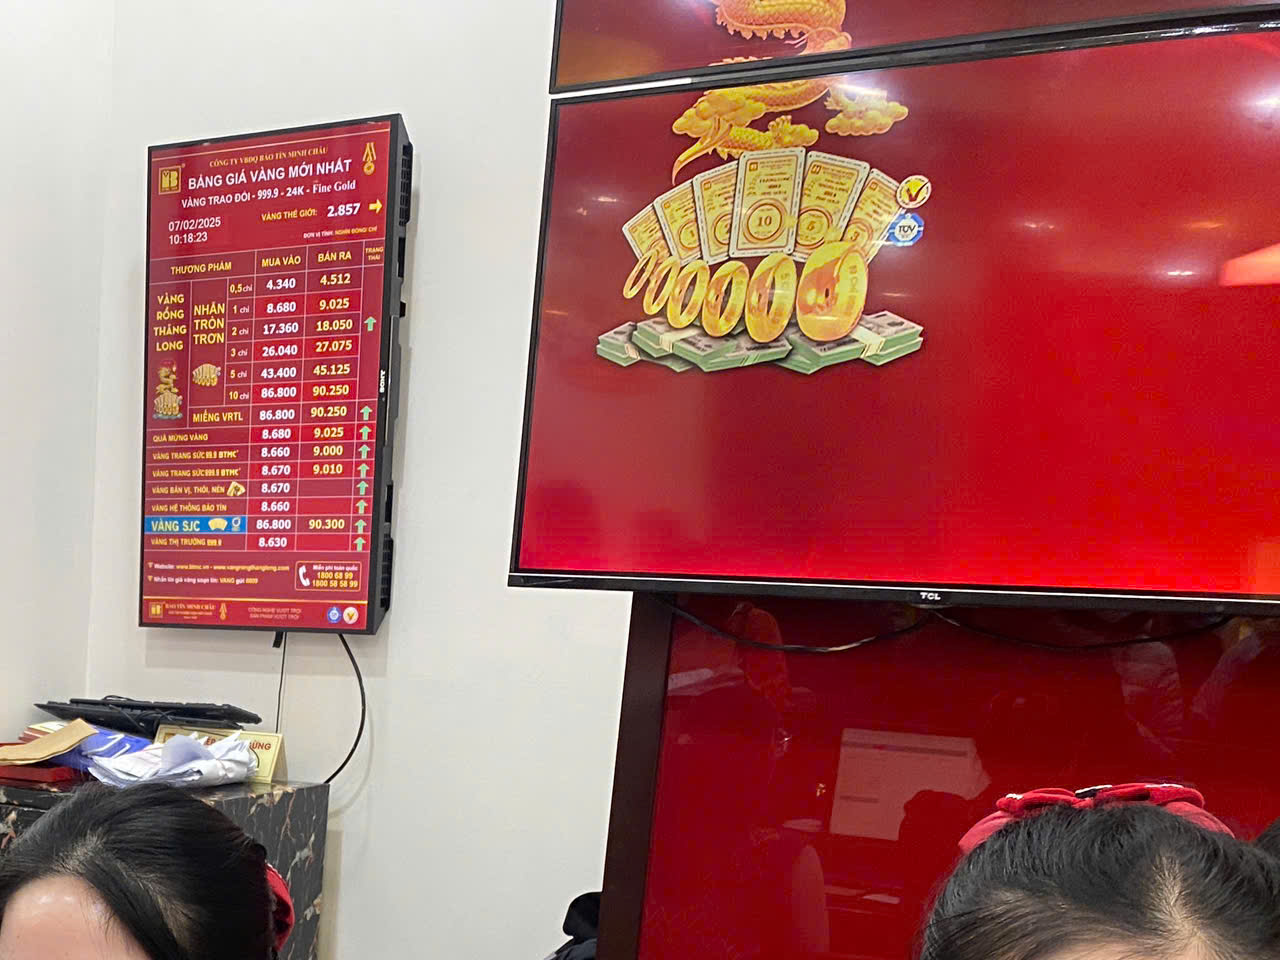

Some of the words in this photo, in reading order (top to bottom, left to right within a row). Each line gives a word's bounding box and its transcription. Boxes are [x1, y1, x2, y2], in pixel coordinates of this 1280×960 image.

[188, 173, 223, 190] BẢNG
[226, 169, 247, 185] GIÁ
[250, 166, 285, 182] VÀNG
[288, 162, 313, 178] MỚI
[182, 196, 206, 208] VÀNG
[208, 194, 233, 205] TRAO
[257, 188, 279, 200] 999.9
[286, 186, 305, 197] 24K
[313, 183, 332, 194] Fine
[334, 180, 356, 192] Gold
[327, 203, 361, 218] 2.857
[168, 217, 221, 232] 07/02/2025
[757, 215, 772, 226] 10
[169, 232, 208, 245] 10:18:23
[171, 264, 206, 275] THƯƠNG
[262, 258, 281, 268] MUA
[283, 254, 301, 266] VÀO
[318, 251, 337, 262] BÁN
[339, 251, 352, 260] RA
[266, 278, 296, 290] 4.340
[320, 273, 351, 286] 4.512
[157, 292, 184, 305] VÀNG
[233, 305, 237, 314] 1
[267, 302, 296, 314] 8.680
[320, 298, 350, 310] 9.025
[232, 327, 237, 336] 2
[263, 323, 299, 335] 17.360
[316, 319, 353, 332] 18.050
[156, 341, 183, 352] LONG
[231, 348, 236, 357] 3
[262, 345, 298, 357] 26.040
[316, 340, 353, 352] 27.075
[230, 370, 236, 379] 5
[261, 367, 297, 379] 43.400
[313, 364, 350, 376] 45.125
[229, 392, 239, 400] 10
[261, 387, 297, 398] 86.800
[312, 385, 350, 396] 90.250
[222, 412, 243, 422] VRTL
[260, 409, 295, 420] 86.800
[311, 406, 348, 418] 90.250
[262, 429, 291, 440] 8.680
[314, 427, 344, 438] 9.025
[261, 447, 290, 457] 8.660
[313, 446, 343, 456] 9.000
[261, 465, 291, 476] 8.670
[313, 464, 343, 474] 9.010
[261, 483, 291, 493] 8.670
[261, 502, 290, 512] 8.660
[152, 518, 179, 531] VÀNG
[182, 521, 201, 531] SJC
[256, 520, 292, 530] 86.800
[309, 519, 345, 529] 90.300
[258, 537, 288, 547] 8.630
[318, 572, 333, 580] 1800
[334, 572, 343, 580] 68
[345, 572, 354, 580] 99
[920, 592, 941, 600] TCL
